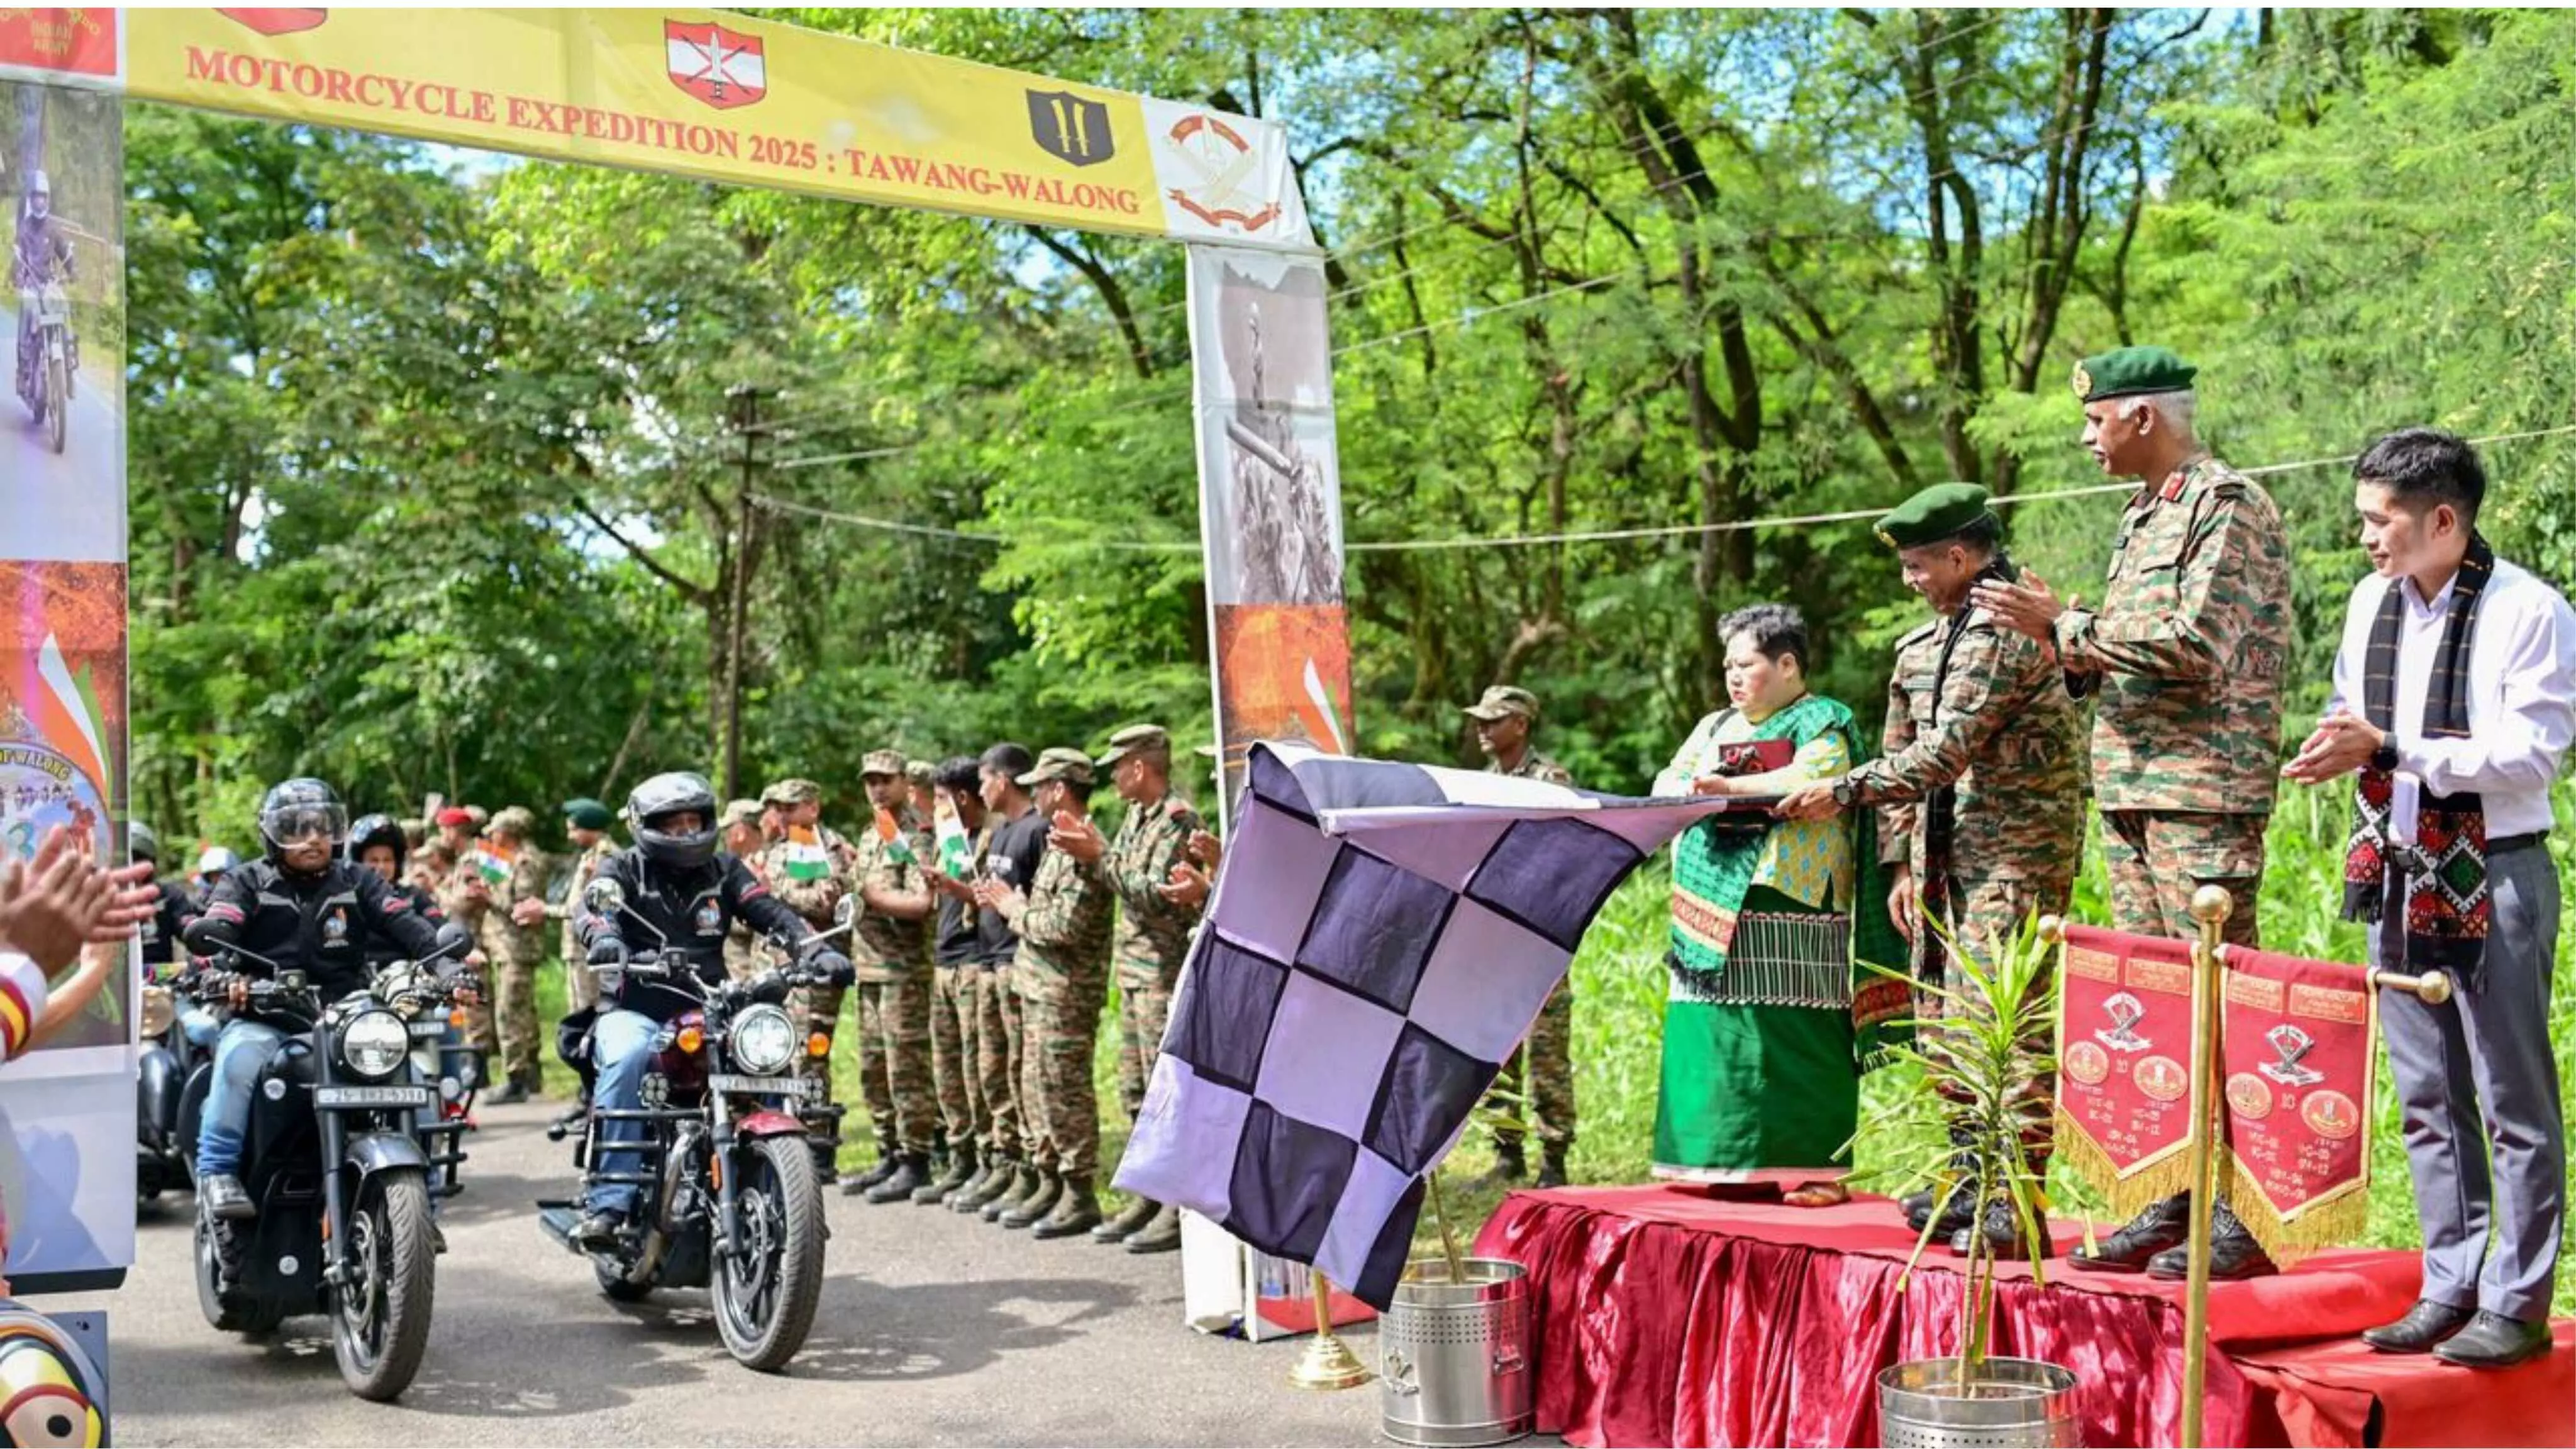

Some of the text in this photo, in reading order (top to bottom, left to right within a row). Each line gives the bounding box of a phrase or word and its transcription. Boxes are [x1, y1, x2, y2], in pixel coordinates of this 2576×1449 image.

[185, 46, 495, 123] MOTORCYCLE
[506, 97, 739, 160] EXPEDITION
[748, 135, 816, 170] 2025
[844, 148, 1140, 215] TAWANG-WALONG
[13, 748, 70, 780] WALONG
